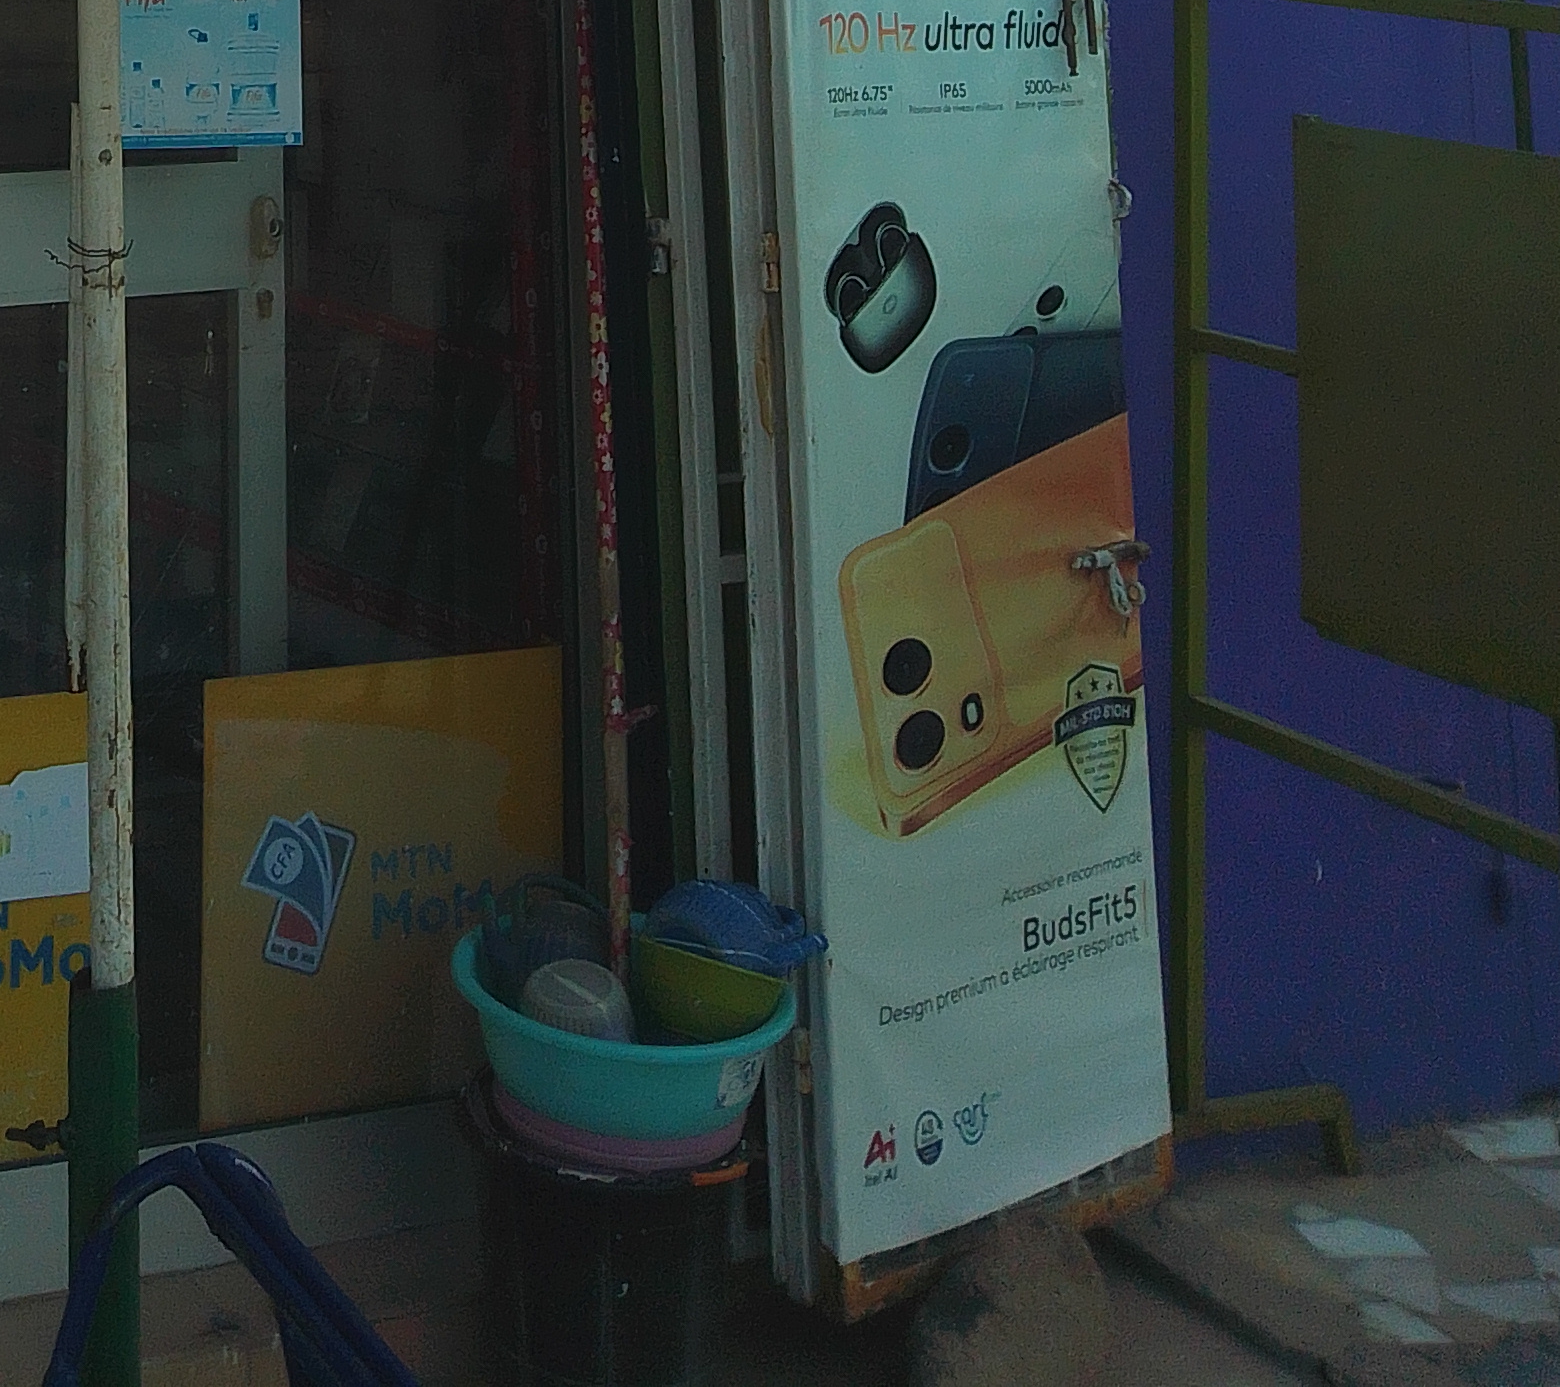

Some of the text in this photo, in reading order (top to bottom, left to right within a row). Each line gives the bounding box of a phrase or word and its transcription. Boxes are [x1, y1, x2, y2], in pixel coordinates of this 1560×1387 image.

[819, 9, 1064, 55] 120 Hz ultra fluid
[827, 86, 859, 103] 120Hz
[939, 82, 967, 100] IP65
[271, 841, 297, 881] CFA
[370, 840, 453, 883] MTN
[371, 878, 502, 943] MoM
[1022, 884, 1137, 953] BudsFit5
[878, 996, 935, 1026] Design
[935, 975, 998, 1012] premium
[1076, 926, 1142, 960] respirant
